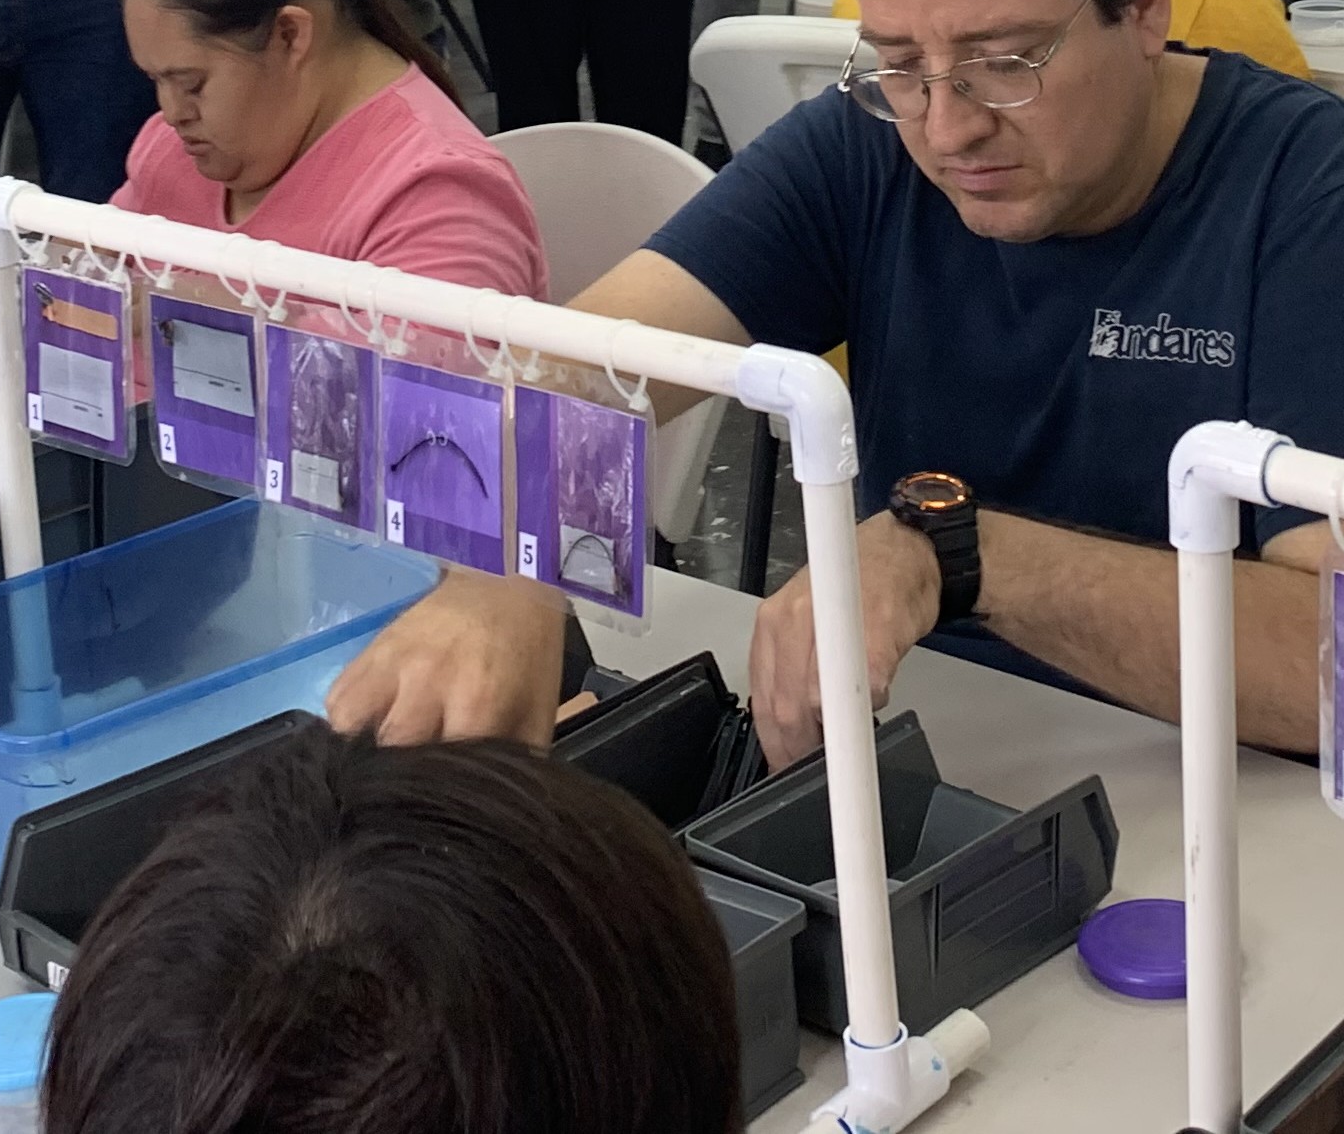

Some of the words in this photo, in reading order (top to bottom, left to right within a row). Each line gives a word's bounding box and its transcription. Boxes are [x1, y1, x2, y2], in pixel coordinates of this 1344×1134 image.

[163, 433, 172, 451] 2
[269, 469, 279, 488] 3
[391, 511, 402, 530] 4
[523, 544, 533, 564] 5
